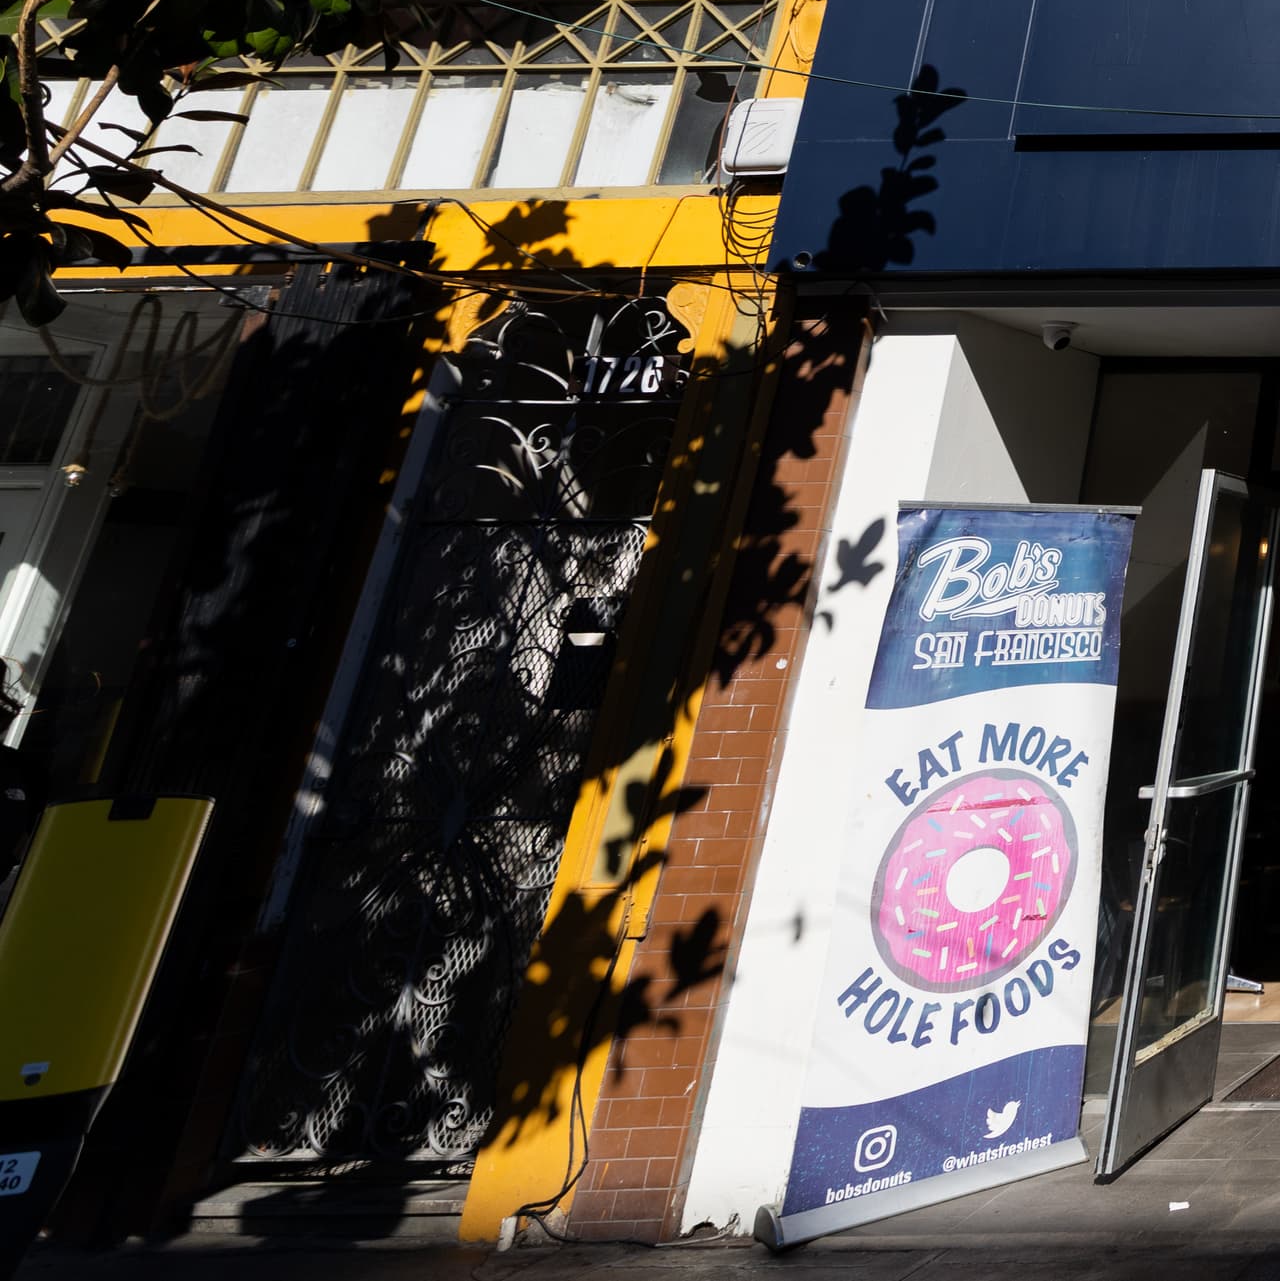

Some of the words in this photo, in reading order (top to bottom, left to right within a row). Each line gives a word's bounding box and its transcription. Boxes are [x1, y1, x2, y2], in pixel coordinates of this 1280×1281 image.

[583, 355, 664, 394] 1726
[917, 536, 1062, 621] Bob's
[1015, 592, 1106, 628] DONUTS
[974, 627, 1104, 667] FRANCISCO
[885, 730, 964, 806] EAT
[978, 722, 1089, 788] MORE
[837, 967, 942, 1048] HOLE
[950, 938, 1081, 1045] FOODS
[943, 1133, 1053, 1173] @whatsfreshest
[825, 1170, 913, 1204] bobsdonuts
